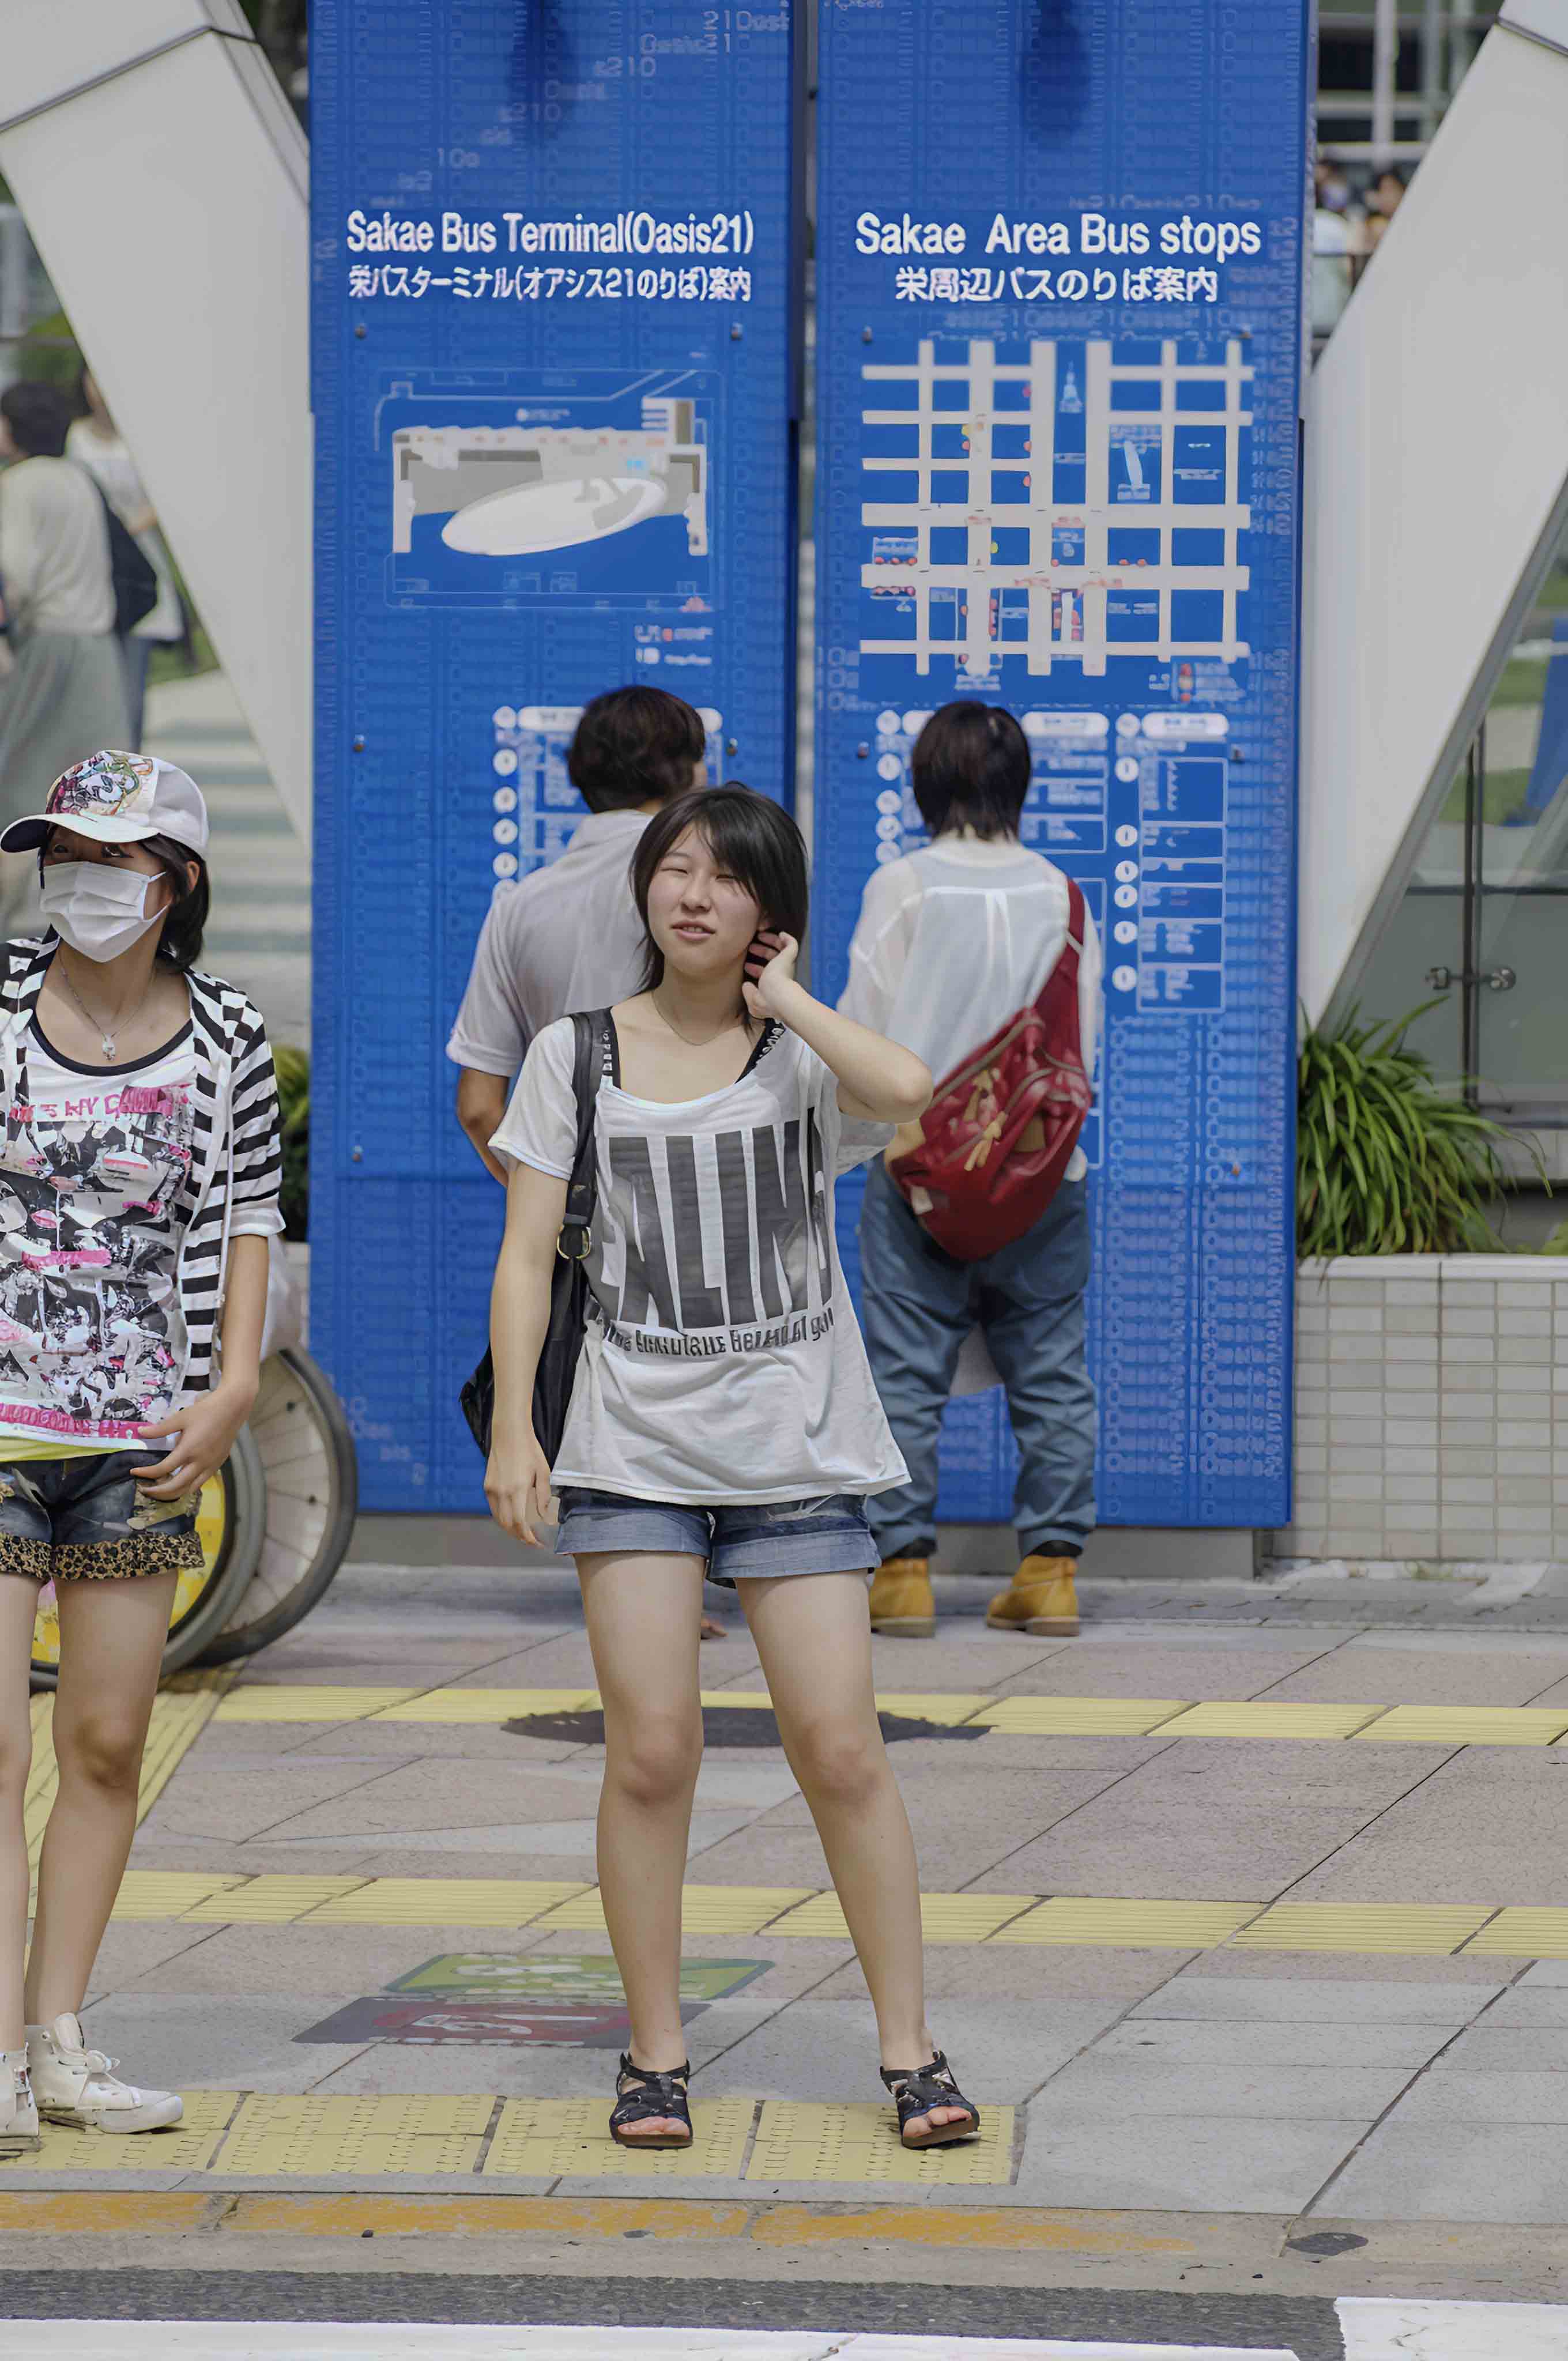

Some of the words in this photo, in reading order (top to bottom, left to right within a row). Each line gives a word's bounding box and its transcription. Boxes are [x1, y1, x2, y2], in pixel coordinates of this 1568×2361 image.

[346, 210, 434, 253] Sakae
[442, 212, 496, 252] Bus
[502, 210, 753, 254] Terminal(Oasis21)
[855, 212, 966, 254] Sakae
[985, 213, 1071, 254] Area
[1080, 213, 1149, 254] Bus
[1159, 214, 1261, 263] stops
[894, 266, 1218, 302] 栄周辺バスのりば案内
